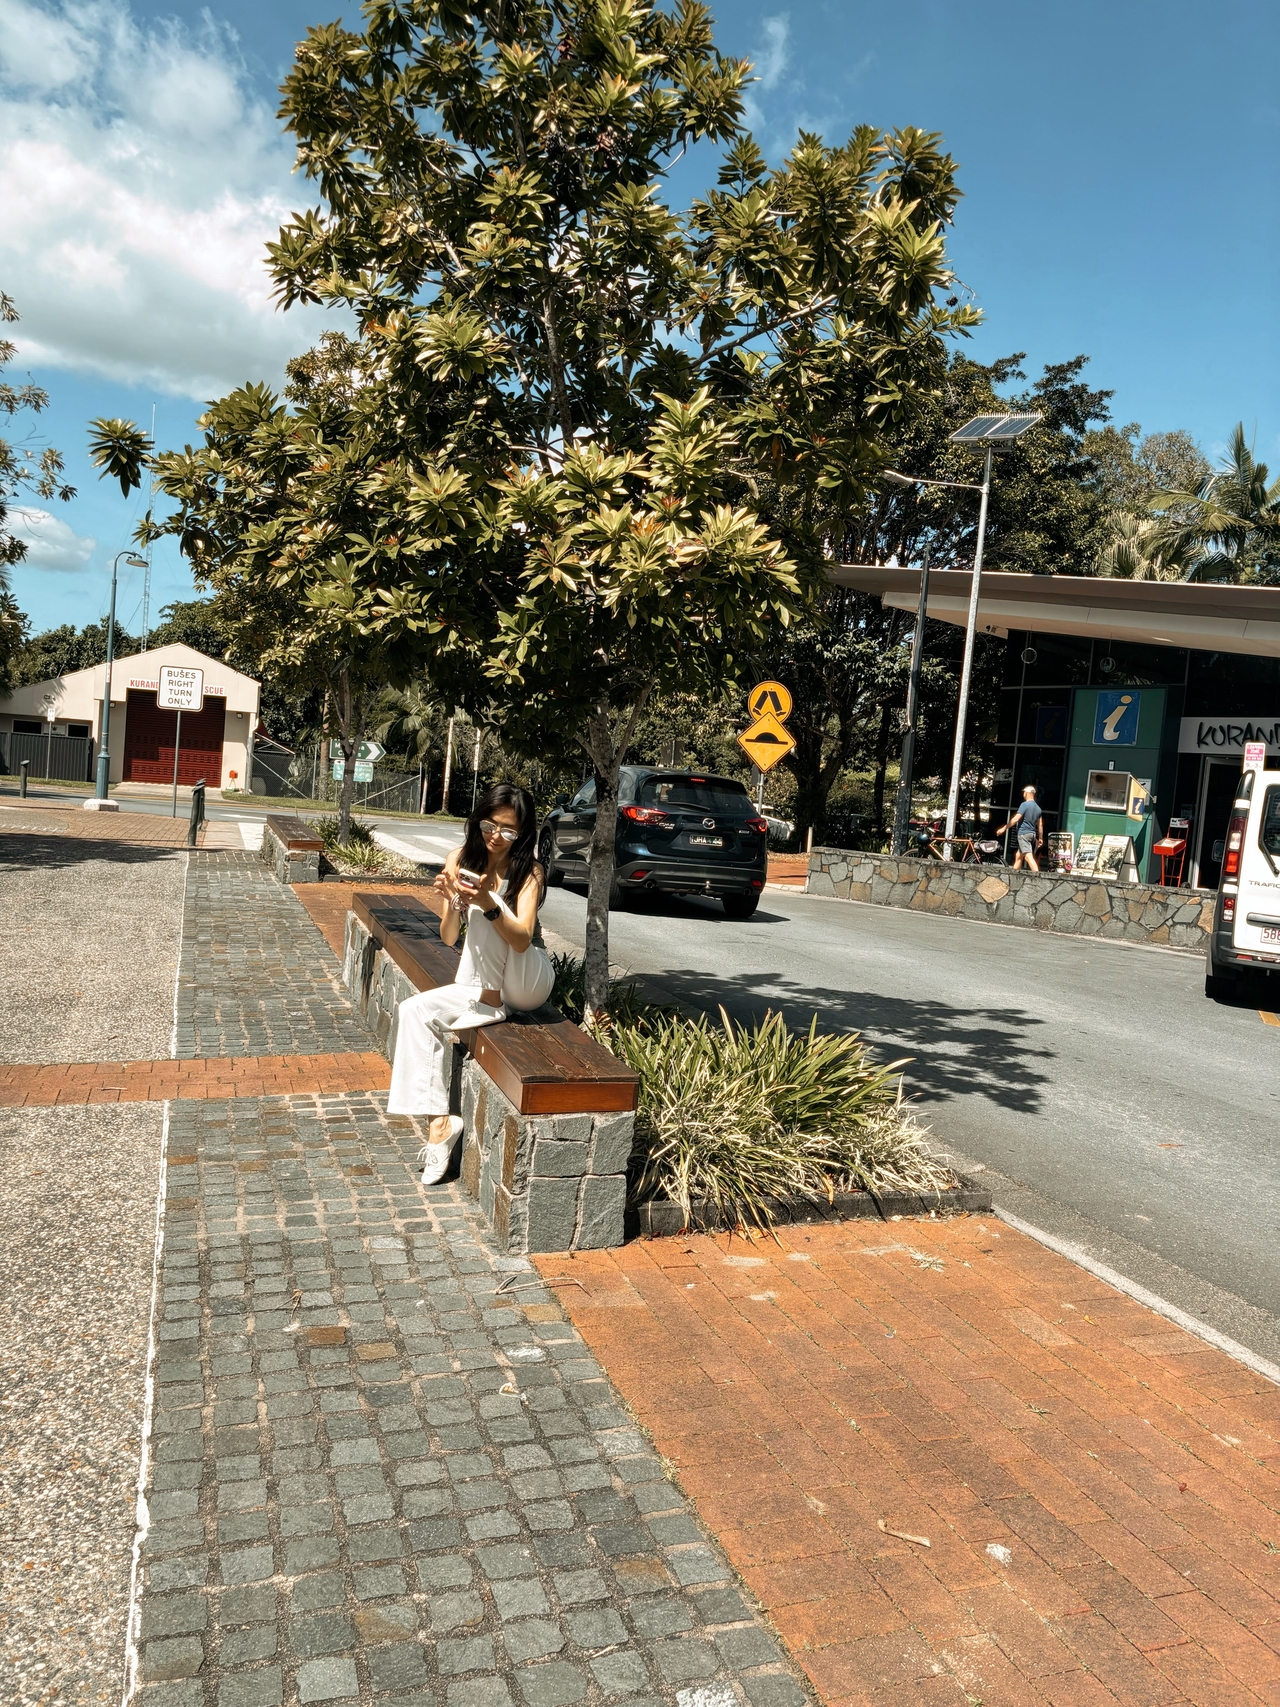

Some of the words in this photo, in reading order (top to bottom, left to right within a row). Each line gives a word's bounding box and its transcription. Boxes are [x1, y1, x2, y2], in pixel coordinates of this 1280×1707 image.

[167, 670, 196, 679] BUSES
[130, 679, 159, 689] KURAND
[204, 685, 224, 695] SCUE
[168, 679, 194, 688] RIGHT
[169, 688, 192, 697] TURN
[167, 697, 192, 706] ONLY
